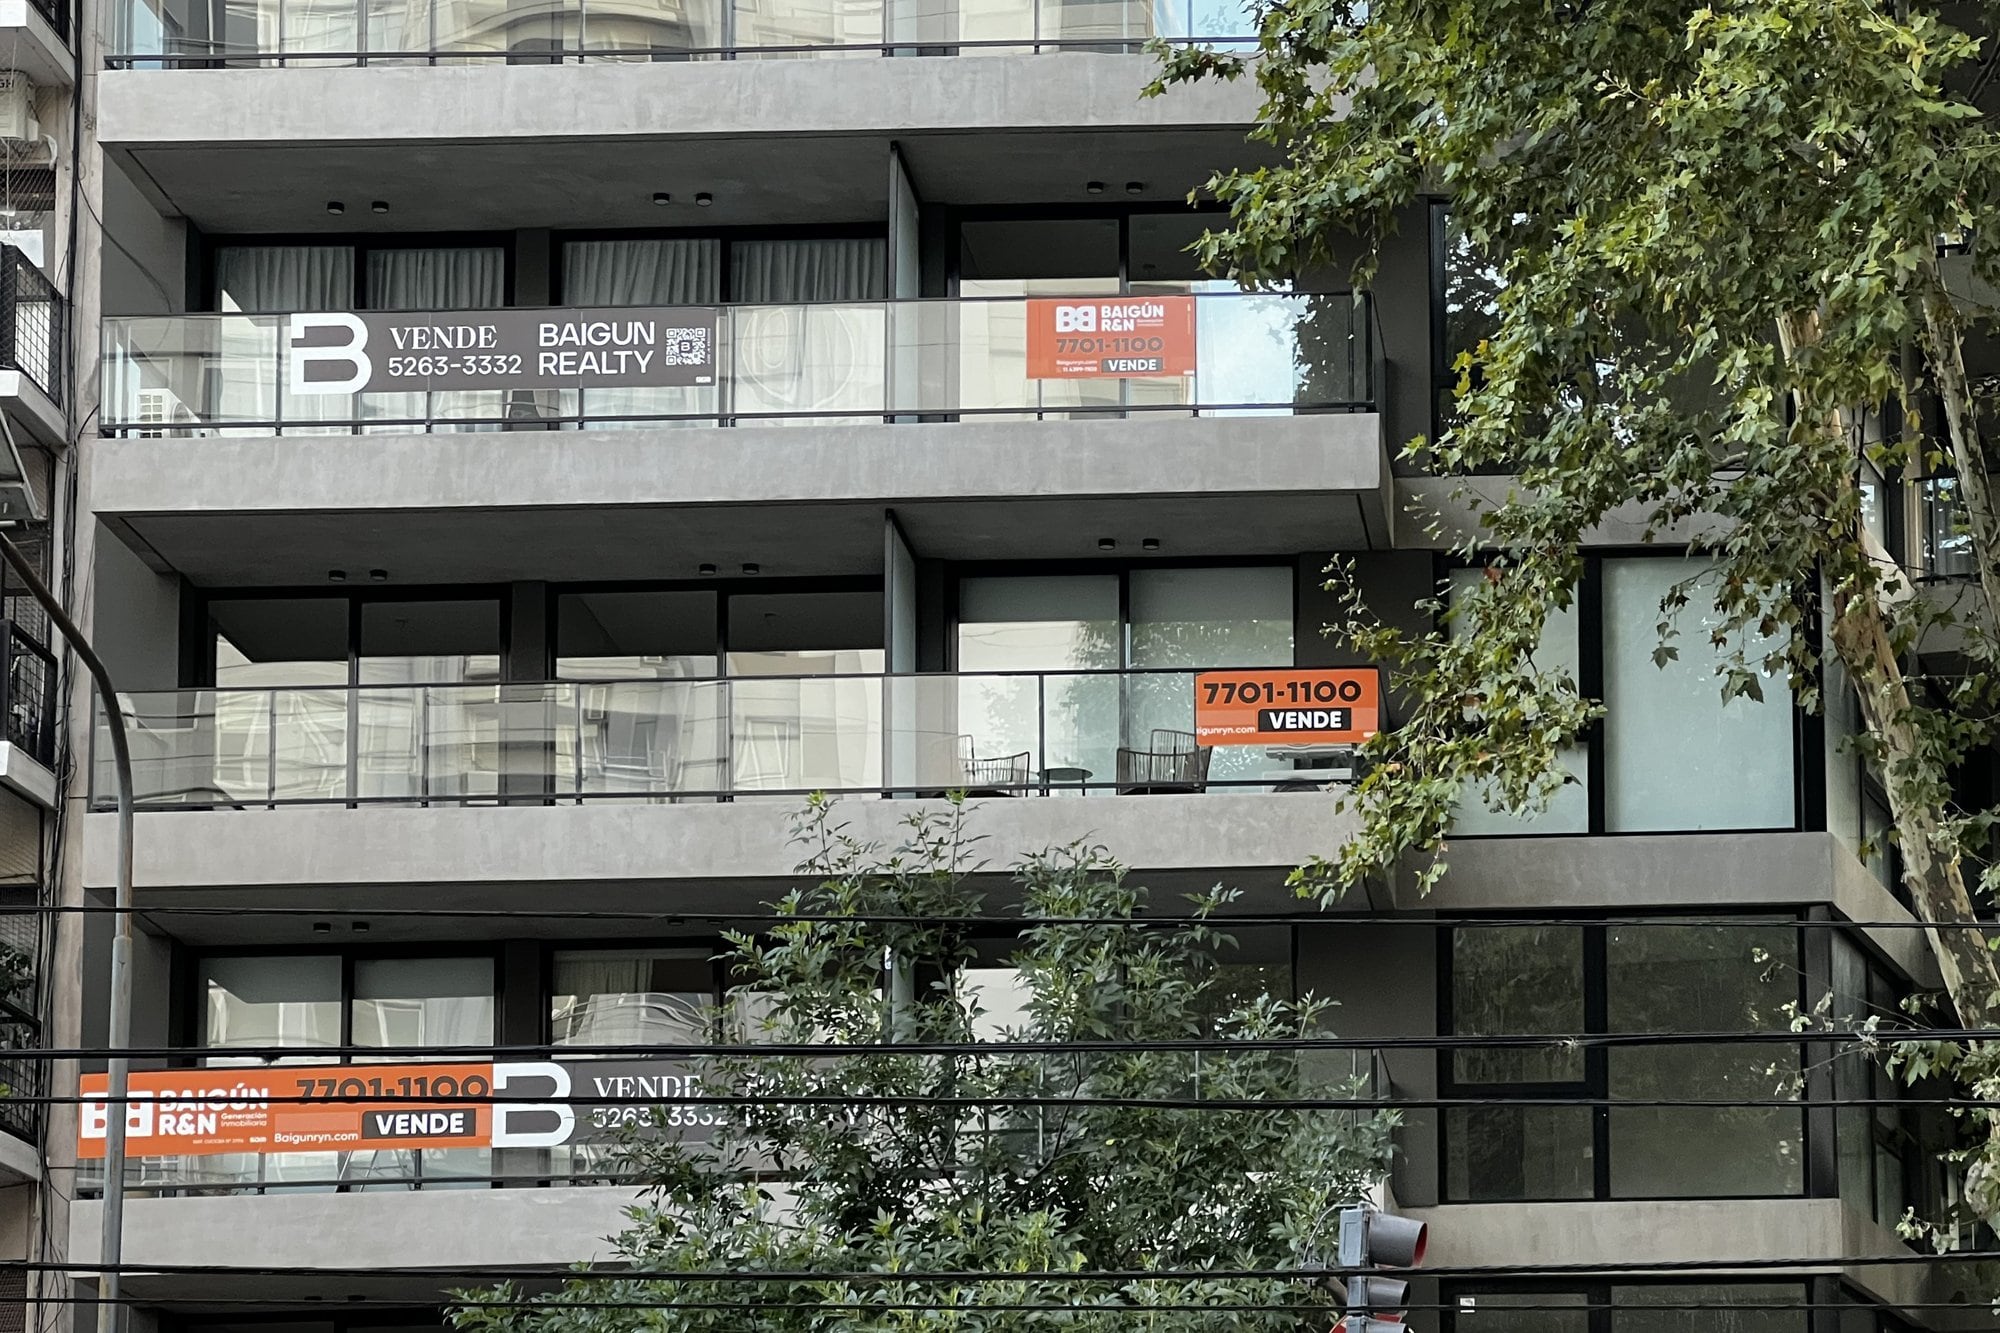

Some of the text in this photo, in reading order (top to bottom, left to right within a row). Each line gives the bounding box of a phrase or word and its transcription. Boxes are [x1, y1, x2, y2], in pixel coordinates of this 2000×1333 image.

[1101, 302, 1164, 318] BAIGÚN
[539, 321, 655, 347] BAIGUN
[1101, 319, 1135, 331] R&N
[389, 325, 498, 350] VENDE
[1056, 337, 1164, 353] 7701-1100
[388, 355, 522, 376] 5263-3332
[538, 350, 655, 376] REALTY
[1108, 359, 1157, 371] VENDE
[1203, 681, 1362, 704] 7701-1100
[1269, 711, 1342, 729] VENDE
[159, 1082, 268, 1112] BAIGÚN
[297, 1075, 489, 1105] 7701-1100
[593, 1075, 704, 1099] VENDE
[159, 1113, 216, 1136] R&N
[375, 1112, 465, 1135] VENDE
[274, 1132, 359, 1144] Baigunryn.com
